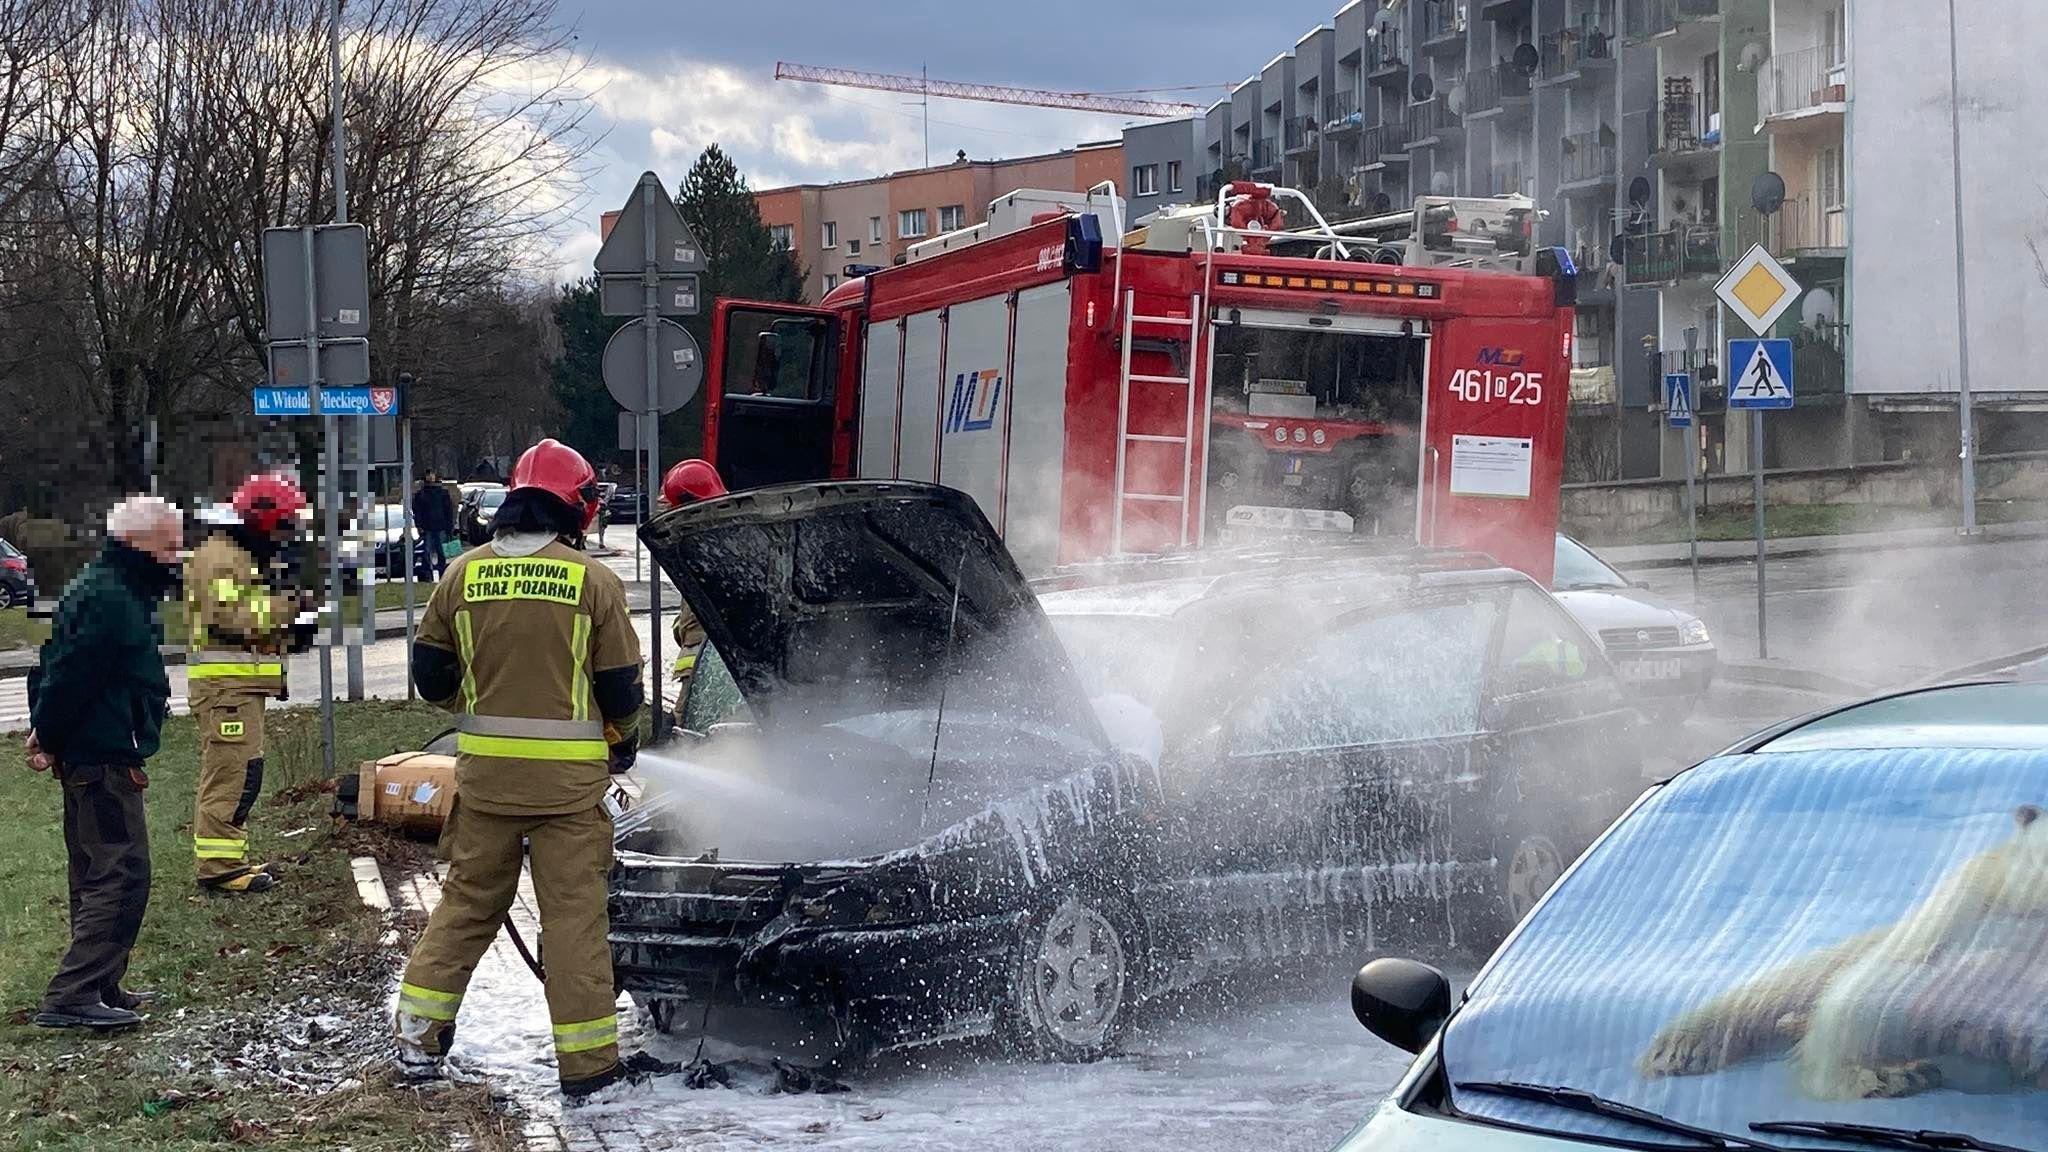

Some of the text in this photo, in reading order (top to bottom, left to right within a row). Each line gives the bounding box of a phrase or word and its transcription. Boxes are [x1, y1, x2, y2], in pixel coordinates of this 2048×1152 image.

[259, 394, 270, 409] ul.
[272, 391, 311, 409] Witold
[478, 561, 568, 580] PAŃSTWOWA
[224, 724, 241, 733] PSP
